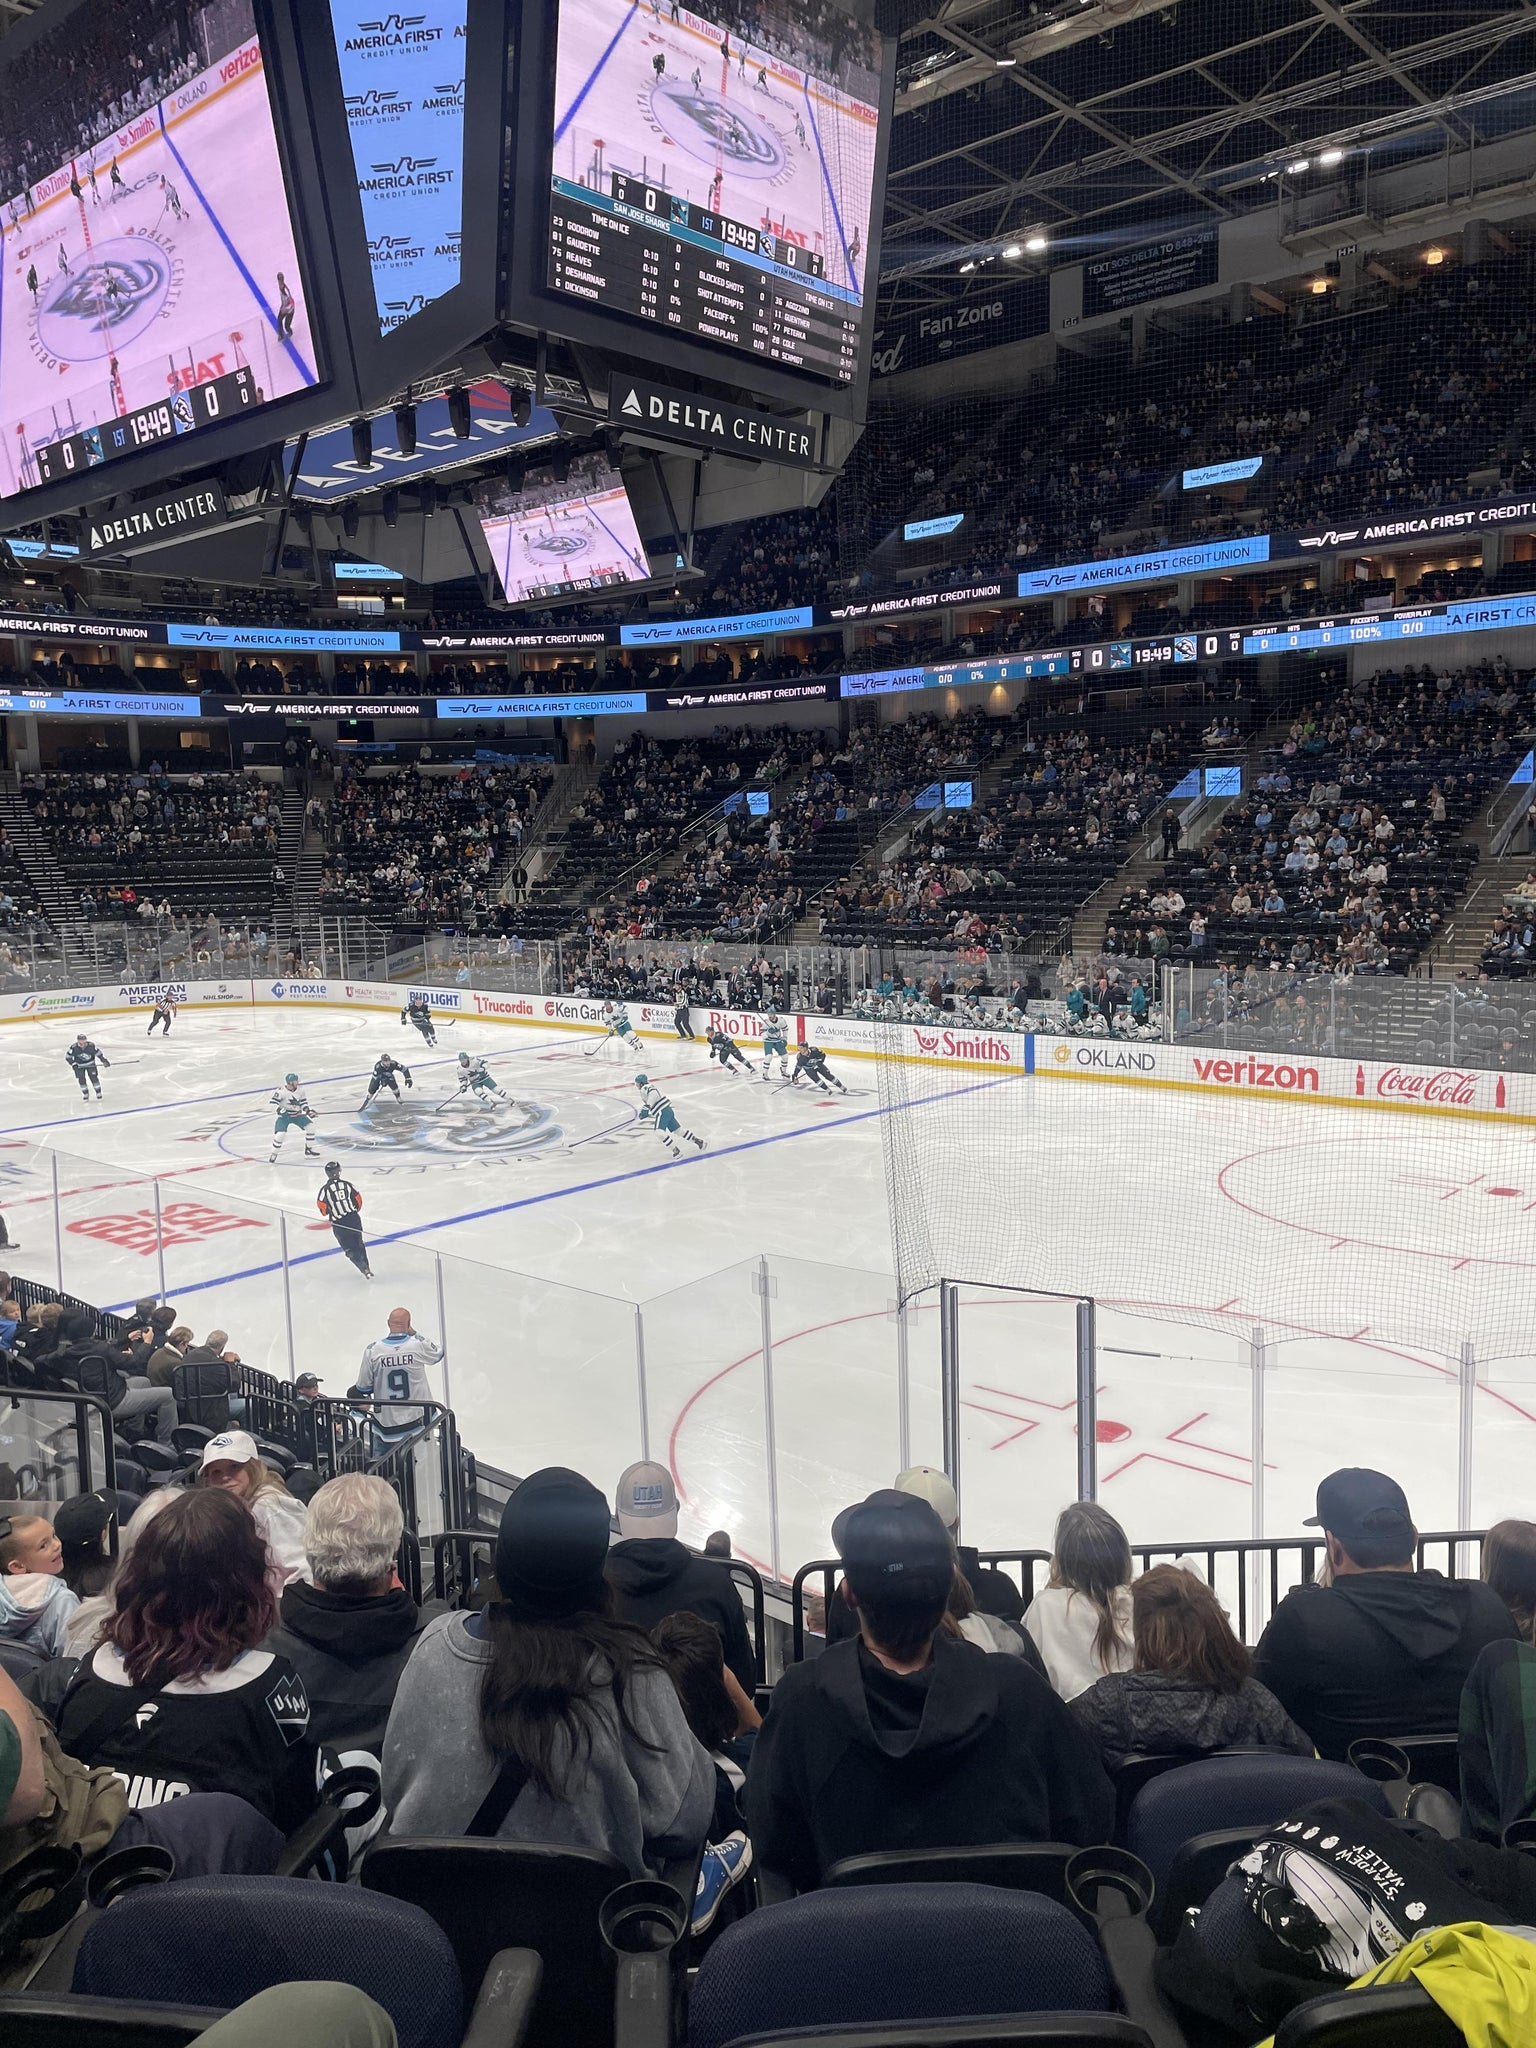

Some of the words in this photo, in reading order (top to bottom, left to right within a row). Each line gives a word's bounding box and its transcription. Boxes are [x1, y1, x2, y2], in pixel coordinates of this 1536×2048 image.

[344, 33, 402, 51] AMERICA
[405, 28, 443, 43] FIRST
[361, 50, 394, 59] CREDIT
[400, 46, 428, 55] UNION
[177, 80, 207, 109] OKLAND
[381, 102, 412, 114] FIRST
[376, 116, 400, 124] UNION
[359, 176, 414, 191] AMERICA
[417, 170, 454, 185] FIRST
[617, 176, 627, 186] SOG
[374, 191, 406, 200] CREDIT
[411, 188, 440, 196] UNION
[645, 189, 657, 212] 0
[592, 212, 608, 227] TIME
[618, 223, 630, 235] ICE
[613, 202, 628, 215] SAN
[627, 208, 645, 221] JOSE
[645, 214, 671, 232] SHARKS
[553, 216, 563, 227] 23
[567, 221, 599, 240] GOODROW
[702, 216, 713, 231] 1ST
[721, 220, 756, 251] 19:49
[552, 231, 562, 242] 81
[566, 236, 600, 256] GAUDETTE
[394, 248, 425, 259] FIRST
[552, 246, 562, 257] 75
[566, 252, 592, 268] REAVES
[643, 249, 659, 262] 0:10
[786, 246, 797, 266] 0
[1088, 262, 1110, 276] TEXT
[1111, 257, 1130, 269] SOS
[1131, 248, 1159, 263] DELTA
[1160, 243, 1174, 256] TO
[643, 263, 658, 276] 0:10
[716, 259, 730, 272] HITS
[565, 266, 606, 288] DESHARNAIS
[642, 277, 657, 290] 0:10
[698, 270, 725, 287] BLOCKED
[725, 279, 744, 294] SHOTS
[788, 269, 815, 287] MAMMOTH
[564, 281, 599, 300] DICKINSON
[641, 292, 657, 304] 0:10
[697, 288, 713, 302] SHOT
[713, 291, 744, 311] ATTEMPTS
[785, 300, 810, 315] AGOZZINO
[640, 306, 656, 318] 0:10
[784, 313, 811, 328] GUENTHER
[919, 316, 953, 338] Fan
[956, 301, 1003, 328] Zone
[668, 312, 681, 323] 0/0
[698, 322, 719, 337] POWER
[719, 328, 739, 343] PLAYS
[753, 340, 765, 350] 0/0
[752, 322, 769, 335] 100%
[783, 326, 807, 340] PETERKA
[782, 339, 796, 350] COLE
[781, 351, 804, 365] SCHMIDT
[166, 353, 226, 391] SEAT
[204, 385, 220, 417] 0
[113, 428, 126, 448] 1ST
[130, 406, 171, 445] 19:49
[649, 395, 725, 435] DELTA
[733, 418, 809, 456] CENTER
[332, 418, 530, 474] DELTA
[62, 442, 75, 470] 0
[103, 512, 153, 544] DELTA
[155, 492, 217, 528] CENTER
[1364, 520, 1429, 539] AMERICA
[1431, 512, 1475, 529] FIRST
[1479, 503, 1530, 521] CREDIT
[1082, 566, 1132, 582] AMERICA
[1134, 560, 1169, 573] FIRST
[1172, 553, 1213, 568] CREDIT
[1214, 547, 1250, 560] UNION
[572, 579, 592, 590] 19:49
[871, 599, 911, 613] AMERICA
[911, 594, 938, 607] FIRST
[940, 589, 971, 602] CREDIT
[972, 585, 1000, 597] UNION
[1350, 615, 1380, 625] FACEOFFS
[1466, 609, 1511, 624] FIRST
[43, 623, 76, 634] FIRST
[79, 625, 115, 636] CREDIT
[116, 627, 148, 639] UNION
[676, 625, 716, 637] AMERICA
[718, 622, 744, 633] FIRST
[746, 619, 774, 630] CREDIT
[775, 615, 800, 626] UNION
[1350, 627, 1381, 639] 100%
[1401, 622, 1423, 634] 0/0
[234, 634, 281, 645] AMERICA
[285, 636, 315, 645] FIRST
[319, 637, 352, 645] CREDIT
[354, 638, 384, 646] UNION
[470, 636, 514, 646] AMERICA
[515, 636, 543, 645] FIRST
[545, 635, 577, 644] CREDIT
[578, 633, 604, 642] UNION
[1205, 636, 1218, 654] 0
[1091, 650, 1103, 667] 0
[1135, 646, 1172, 663] 19:49
[938, 673, 953, 684] 0/0
[970, 670, 984, 680] 0%
[708, 693, 747, 704] AMERICA
[748, 690, 773, 700] FIRST
[773, 688, 802, 698] CREDIT
[801, 685, 826, 695] UNION
[29, 700, 47, 709] 0/0
[79, 699, 111, 709] FIRST
[115, 700, 150, 710] CREDIT
[151, 702, 184, 711] UNION
[275, 704, 322, 714] AMERICA
[323, 705, 353, 714] FIRST
[355, 705, 389, 714] CREDIT
[390, 705, 419, 714] UNION
[497, 704, 541, 713] AMERICA
[542, 703, 571, 712] FIRST
[573, 701, 605, 711] CREDIT
[605, 700, 633, 709] UNION
[119, 984, 186, 996] AMERICAN
[289, 984, 327, 994] moxie
[38, 994, 96, 1007] SameDay
[129, 993, 188, 1005] EXPRSS
[430, 993, 459, 1006] LIGHT
[482, 998, 533, 1015] Trucordia
[556, 1002, 577, 1019] Ken
[652, 1009, 669, 1017] CRAIG
[943, 1031, 1010, 1061] Smith's
[1077, 1048, 1155, 1071] OKLAND
[1193, 1055, 1318, 1091] verizon
[335, 1189, 346, 1200] 18
[380, 1354, 414, 1368] KELLER
[388, 1368, 410, 1400] 9
[633, 1485, 662, 1500] UTAH
[273, 1693, 307, 1714] UTAH
[1336, 1848, 1399, 1901] STARDEW
[1352, 1845, 1406, 1887] VALLEY
